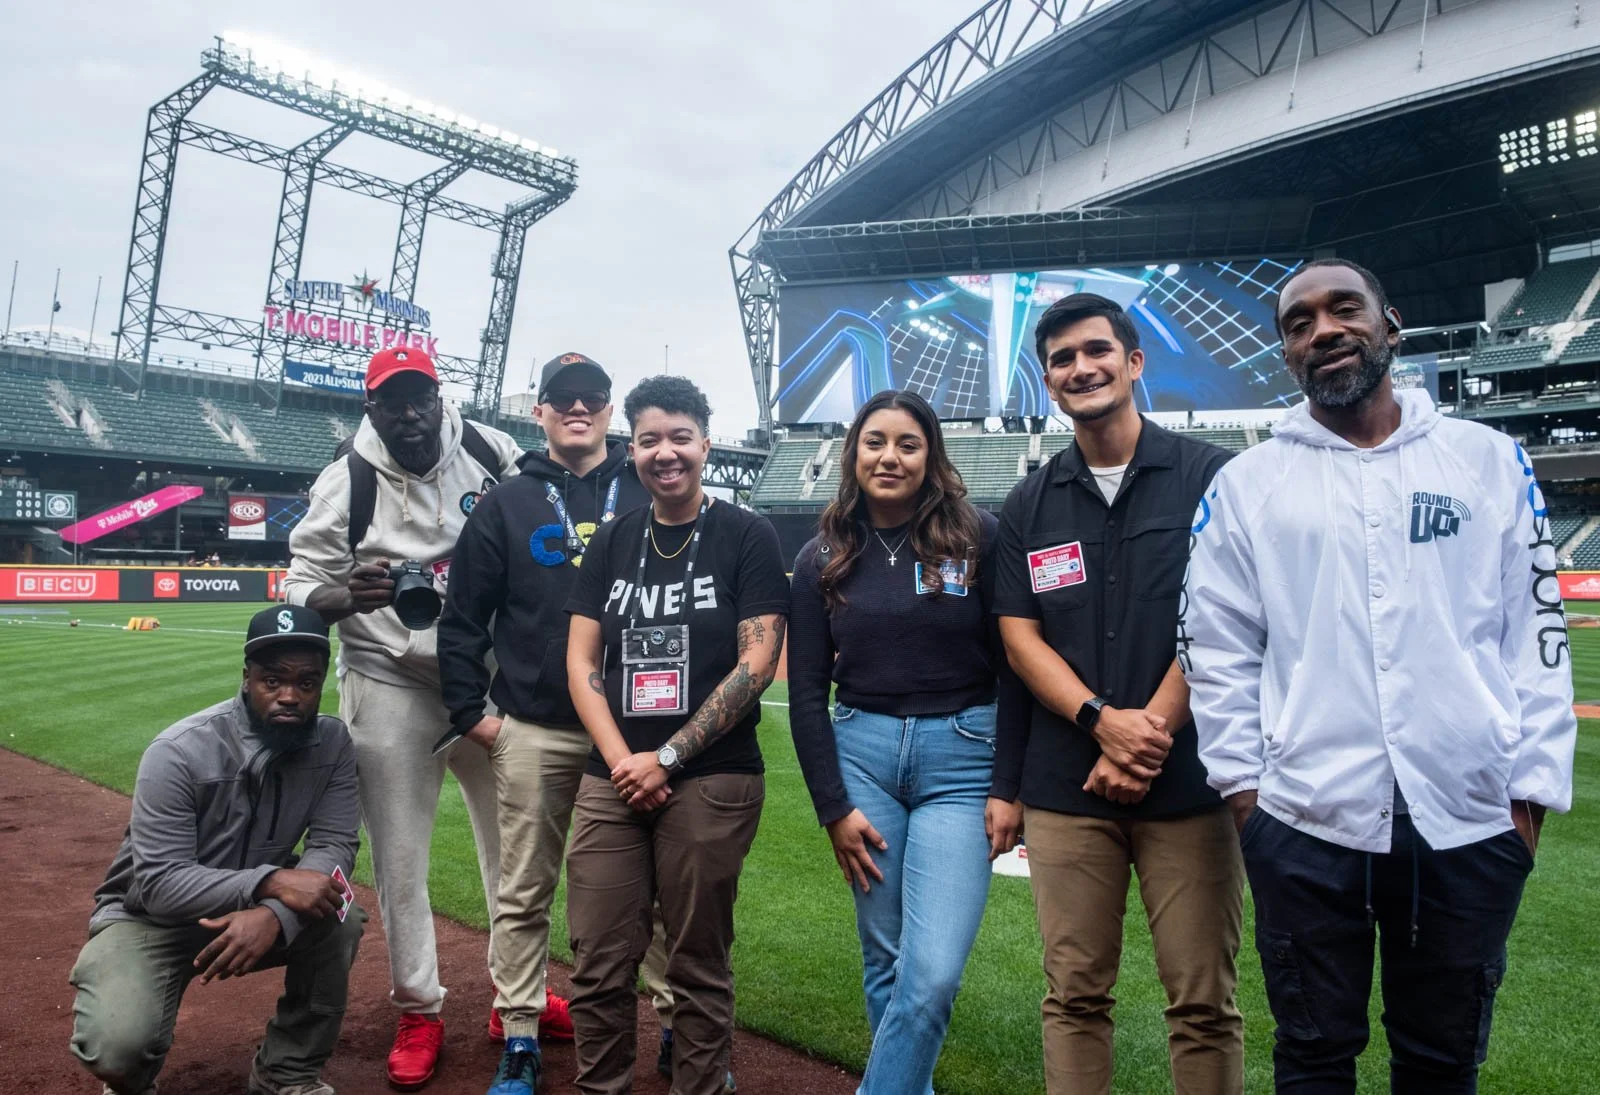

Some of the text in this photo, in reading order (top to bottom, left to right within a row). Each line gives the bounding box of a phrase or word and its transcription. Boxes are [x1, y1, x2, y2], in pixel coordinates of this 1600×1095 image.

[284, 278, 431, 328] SEATTLE MARINERS
[264, 305, 439, 358] T-MOBILE PARK
[303, 371, 324, 385] 2023
[16, 499, 41, 508] 0 0 0
[1412, 491, 1452, 509] ROUND
[16, 509, 40, 518] 0 0 0
[24, 577, 91, 592] BECU
[184, 579, 241, 592] TOYOTA
[604, 575, 718, 619] PINES
[277, 610, 294, 633] S
